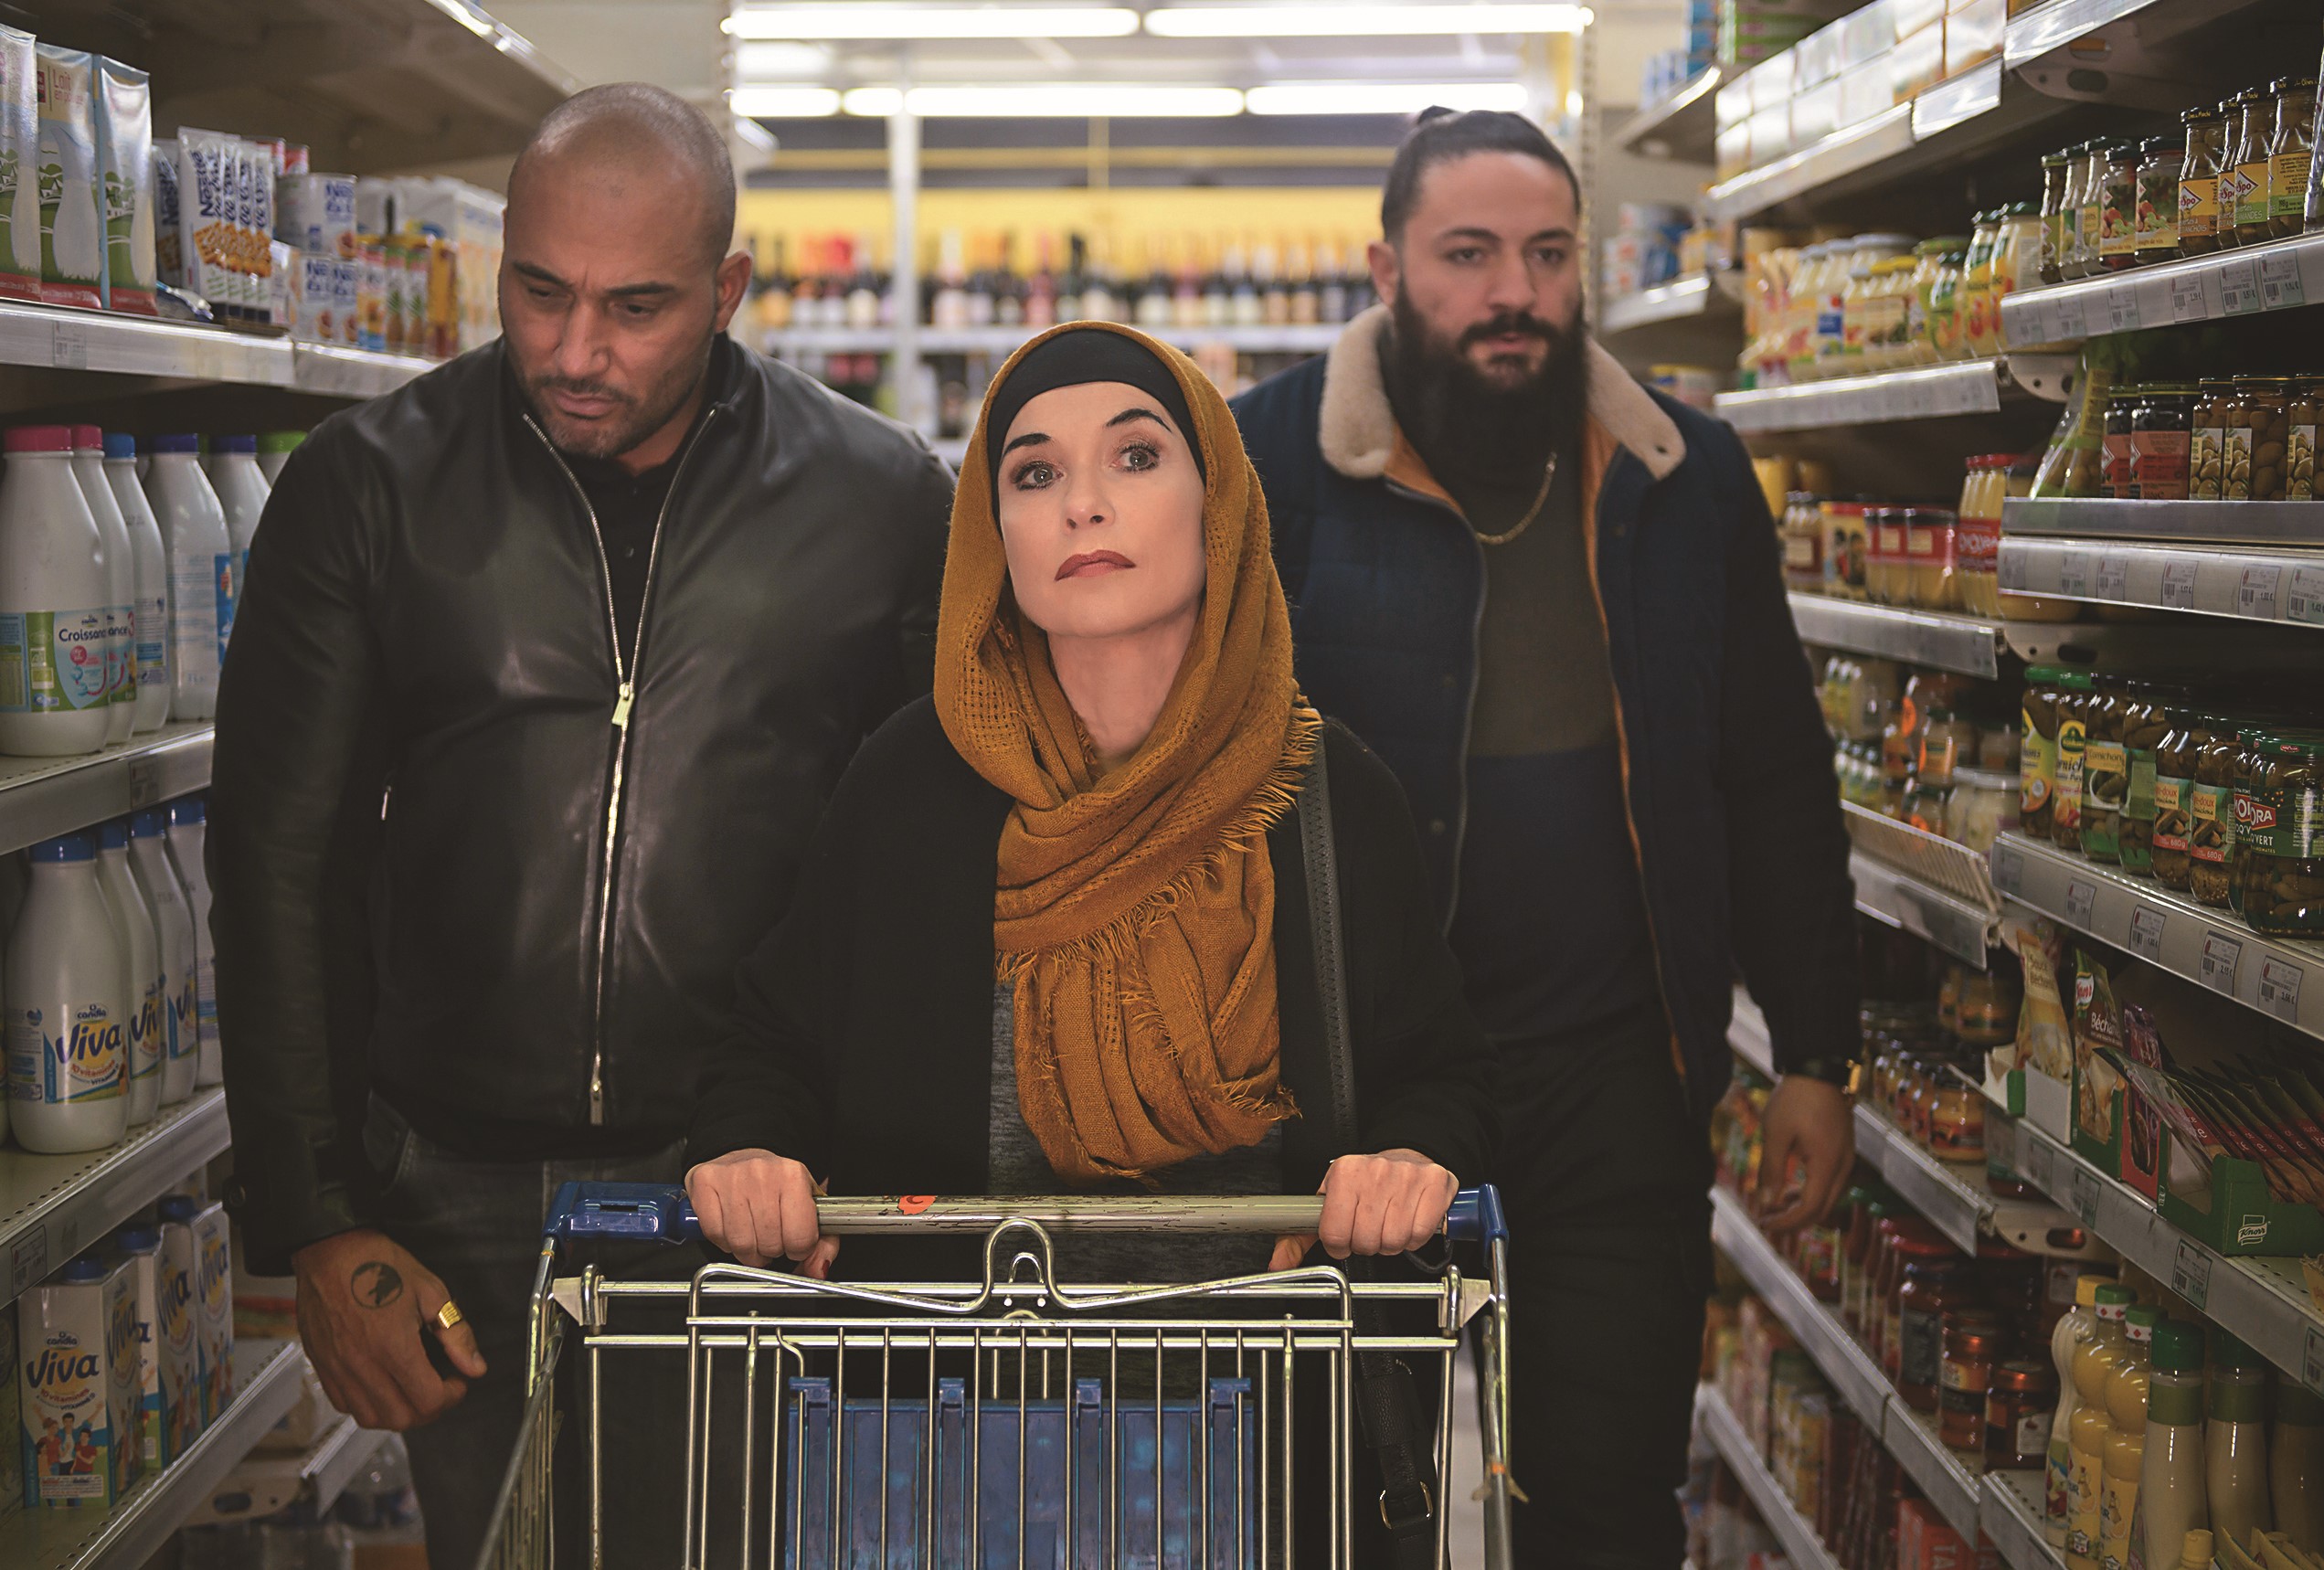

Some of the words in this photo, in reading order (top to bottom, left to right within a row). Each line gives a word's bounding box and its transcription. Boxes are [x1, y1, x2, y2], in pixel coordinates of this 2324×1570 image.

[53, 69, 71, 90] Lait
[56, 1024, 122, 1064] Viva
[2241, 1226, 2267, 1237] Knorr
[47, 1336, 78, 1345] candia
[27, 1349, 100, 1388] Viva
